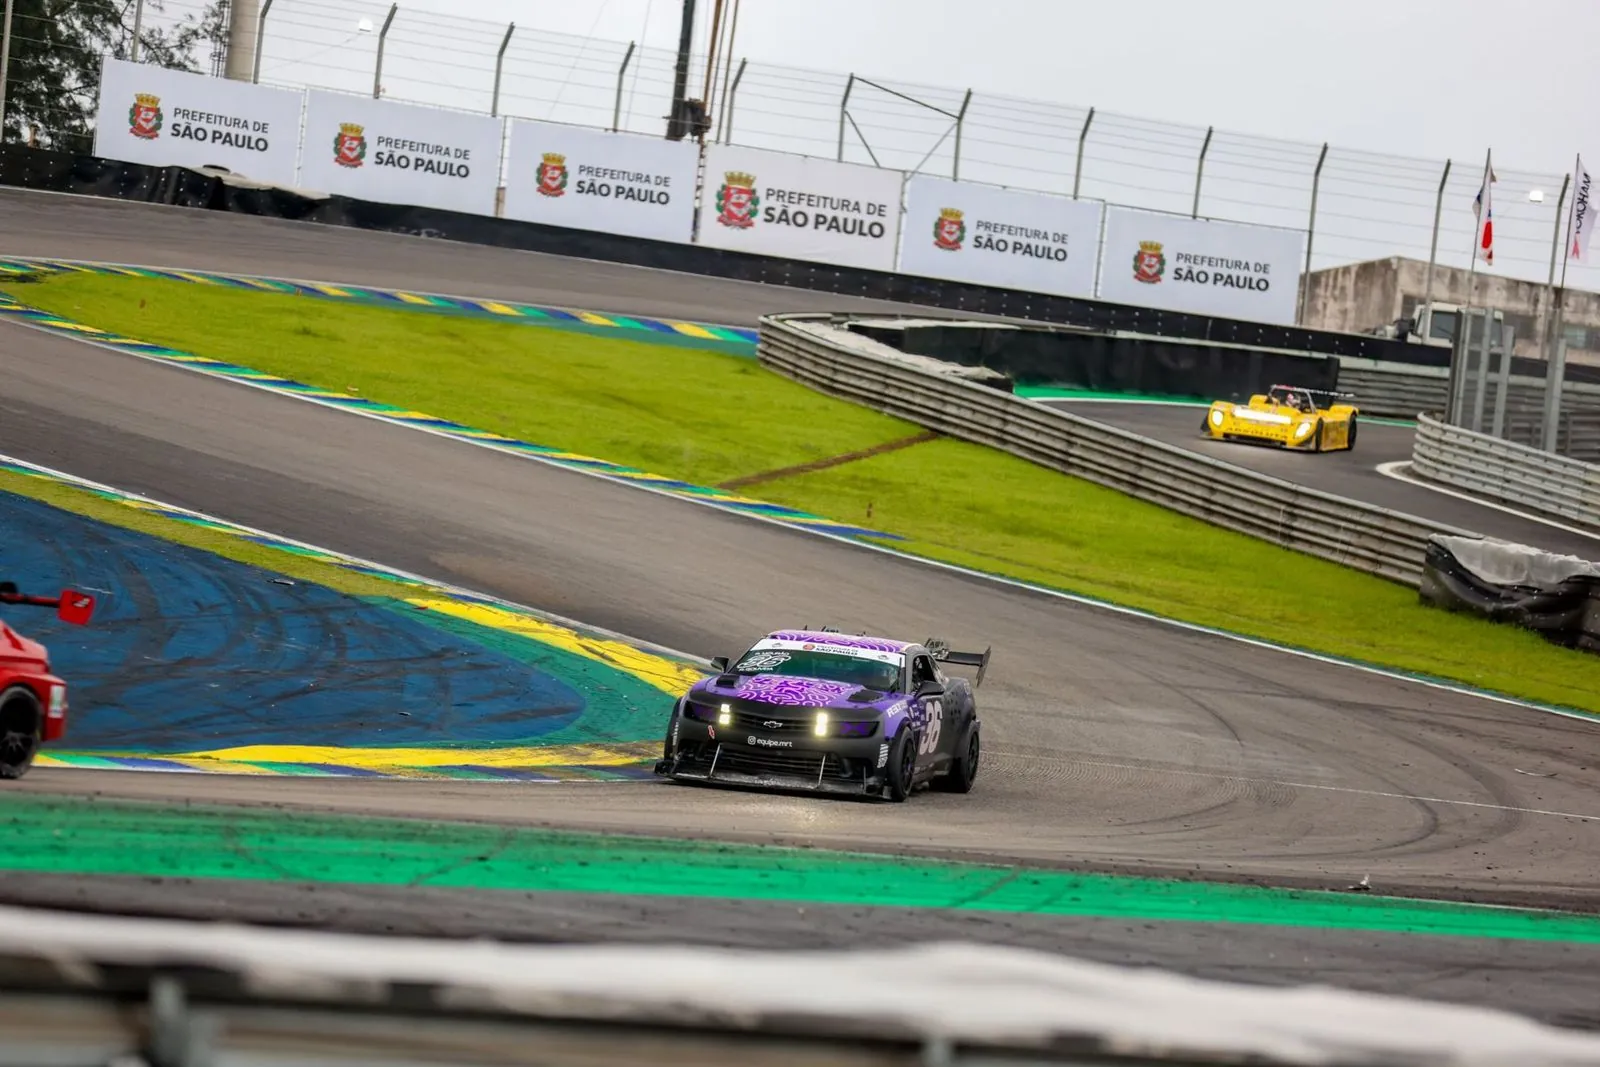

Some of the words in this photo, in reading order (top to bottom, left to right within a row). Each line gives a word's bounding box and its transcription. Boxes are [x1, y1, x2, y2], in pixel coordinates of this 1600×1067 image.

[174, 108, 248, 131] PREFEITURA
[253, 121, 269, 133] DE
[171, 121, 207, 141] SÃO
[212, 130, 269, 152] PAULO
[378, 136, 451, 156] PREFEITURA
[455, 148, 470, 160] DE
[375, 149, 410, 169] SÃO
[414, 158, 470, 178] PAULO
[579, 165, 650, 184] PREFEITURA
[655, 175, 670, 187] DE
[576, 178, 611, 197] SÃO
[615, 186, 669, 205] PAULO
[766, 188, 860, 214] PREFEITURA
[867, 202, 886, 217] DE
[764, 204, 808, 227] SÃO
[814, 213, 884, 238] PAULO
[977, 221, 1048, 241] PREFEITURA
[1053, 232, 1068, 244] DE
[974, 234, 1009, 252] SÃO
[1012, 241, 1068, 261] PAULO
[1176, 253, 1249, 272] PREFEITURA
[1254, 262, 1269, 273] DE
[1172, 265, 1210, 284] SÃO
[1213, 273, 1270, 292] PAULO
[919, 700, 943, 755] 36
[757, 739, 793, 748] equipe.mrt
